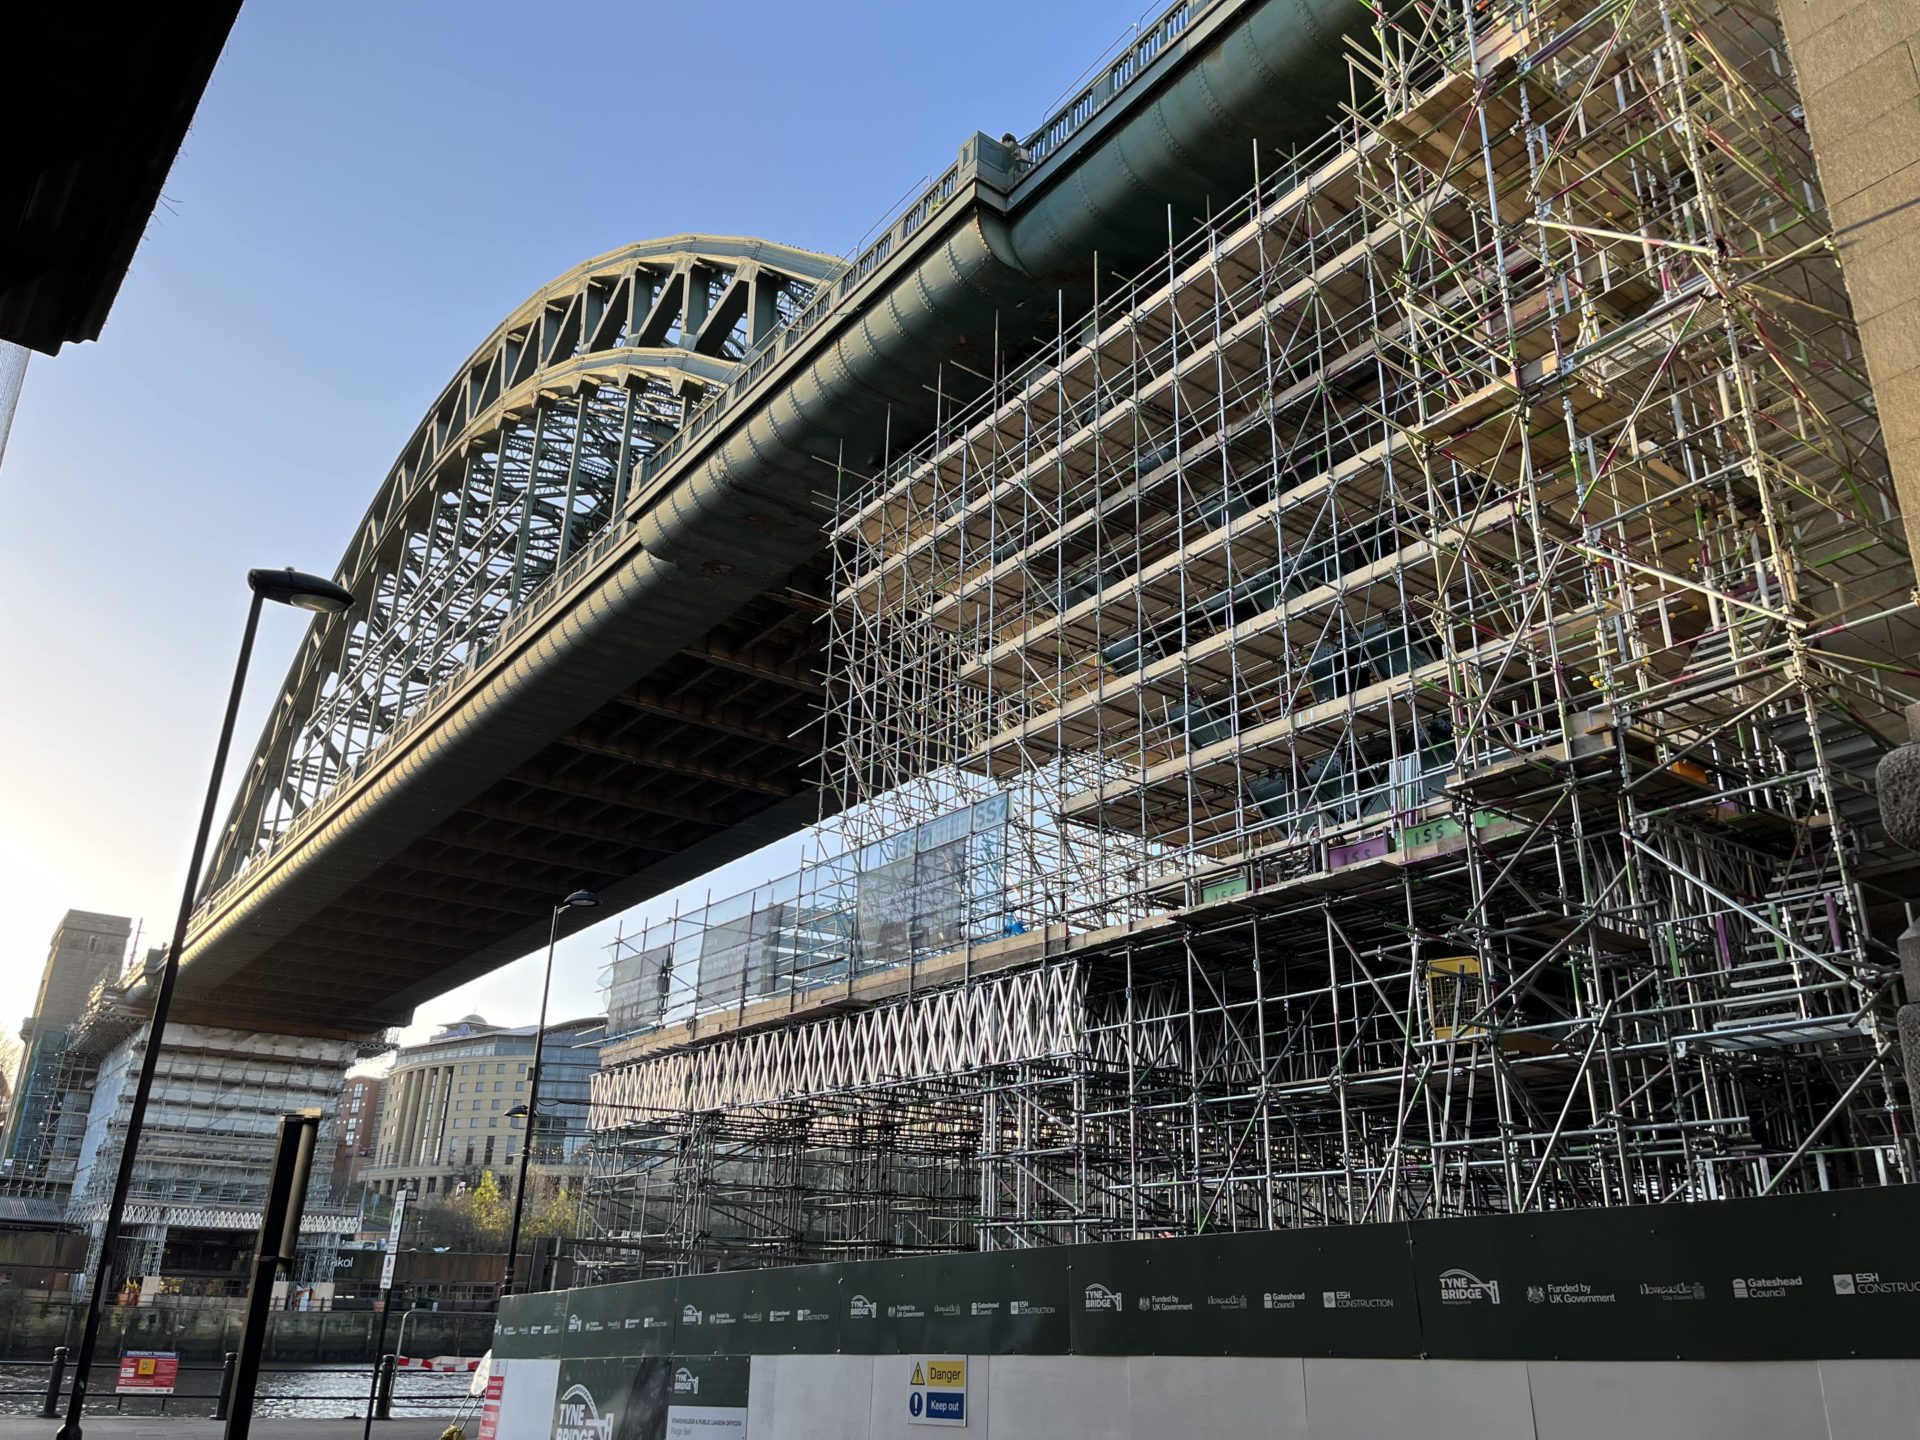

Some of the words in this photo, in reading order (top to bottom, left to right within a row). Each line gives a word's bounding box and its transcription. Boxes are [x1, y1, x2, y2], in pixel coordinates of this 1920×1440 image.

[1416, 824, 1445, 845] ISS
[1440, 1278, 1468, 1288] TYNE
[1748, 1276, 1803, 1288] Gateshead
[1855, 1273, 1879, 1283] ESH
[1547, 1284, 1578, 1293] Funded
[1580, 1284, 1591, 1294] by
[1749, 1287, 1786, 1298] Council
[1857, 1281, 1920, 1294] CONSTRUC
[1085, 1291, 1103, 1299] TYNE
[1272, 1292, 1305, 1300] Gateshead
[1336, 1291, 1351, 1299] ESH
[1441, 1288, 1482, 1300] BRIDGE
[1549, 1294, 1563, 1304] UK
[1564, 1293, 1616, 1304] Government
[1085, 1299, 1111, 1308] BRIDGE
[1171, 1296, 1179, 1304] by
[1273, 1301, 1295, 1309] Council
[1337, 1299, 1394, 1308] CONSTRUCTION
[850, 1308, 869, 1316] BRIDGE
[1161, 1303, 1193, 1311] Government
[930, 1367, 961, 1383] Danger
[675, 1382, 691, 1390] BRIDGE
[931, 1400, 947, 1412] Keep
[949, 1401, 959, 1411] out
[559, 1404, 585, 1426] TYNE
